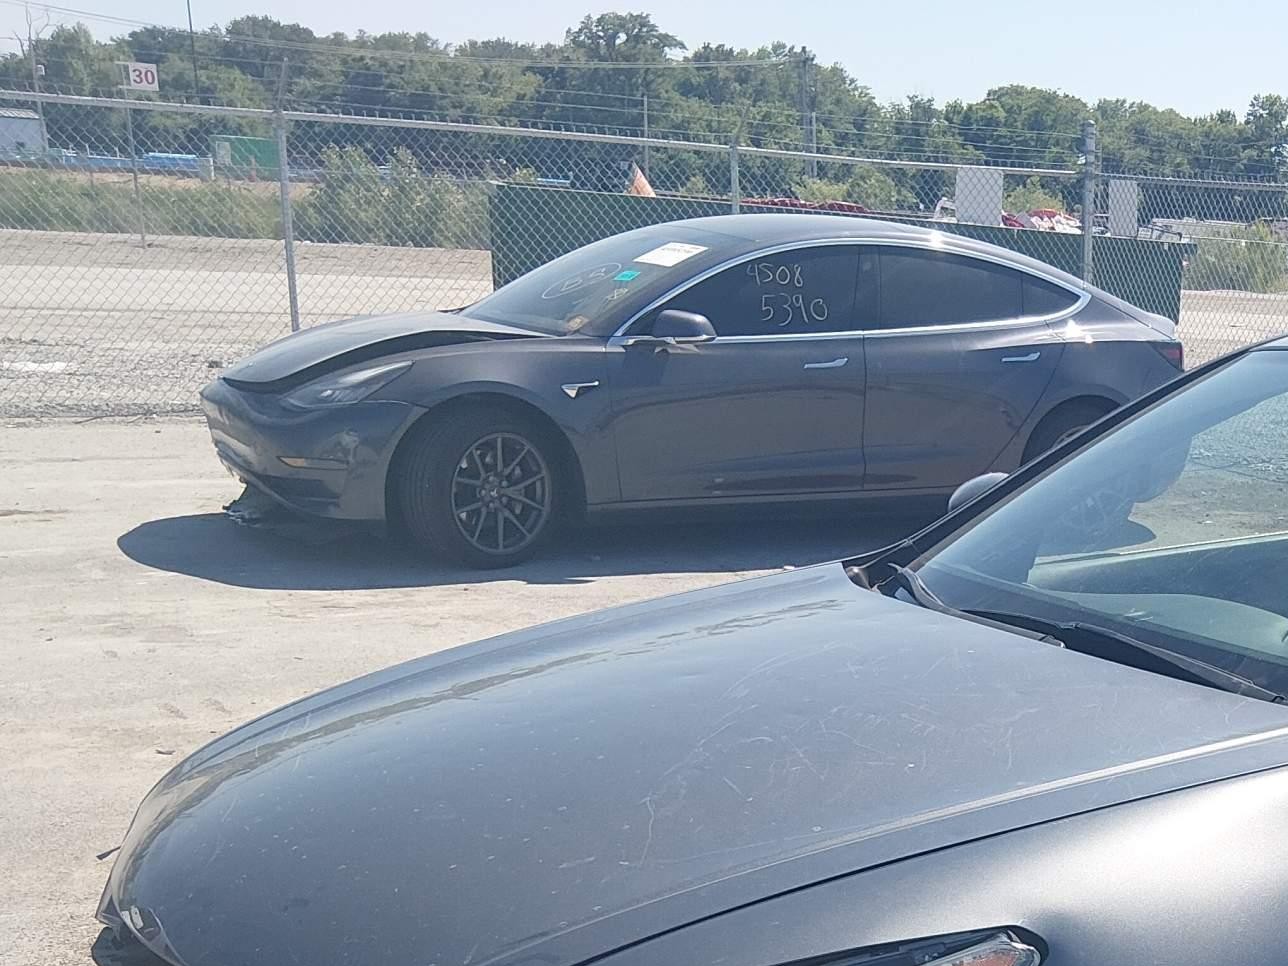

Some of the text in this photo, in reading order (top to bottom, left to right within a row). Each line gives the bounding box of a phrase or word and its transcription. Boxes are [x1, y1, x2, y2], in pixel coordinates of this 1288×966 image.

[132, 68, 156, 85] 30
[746, 262, 804, 287] 4508
[761, 292, 829, 326] 5390
